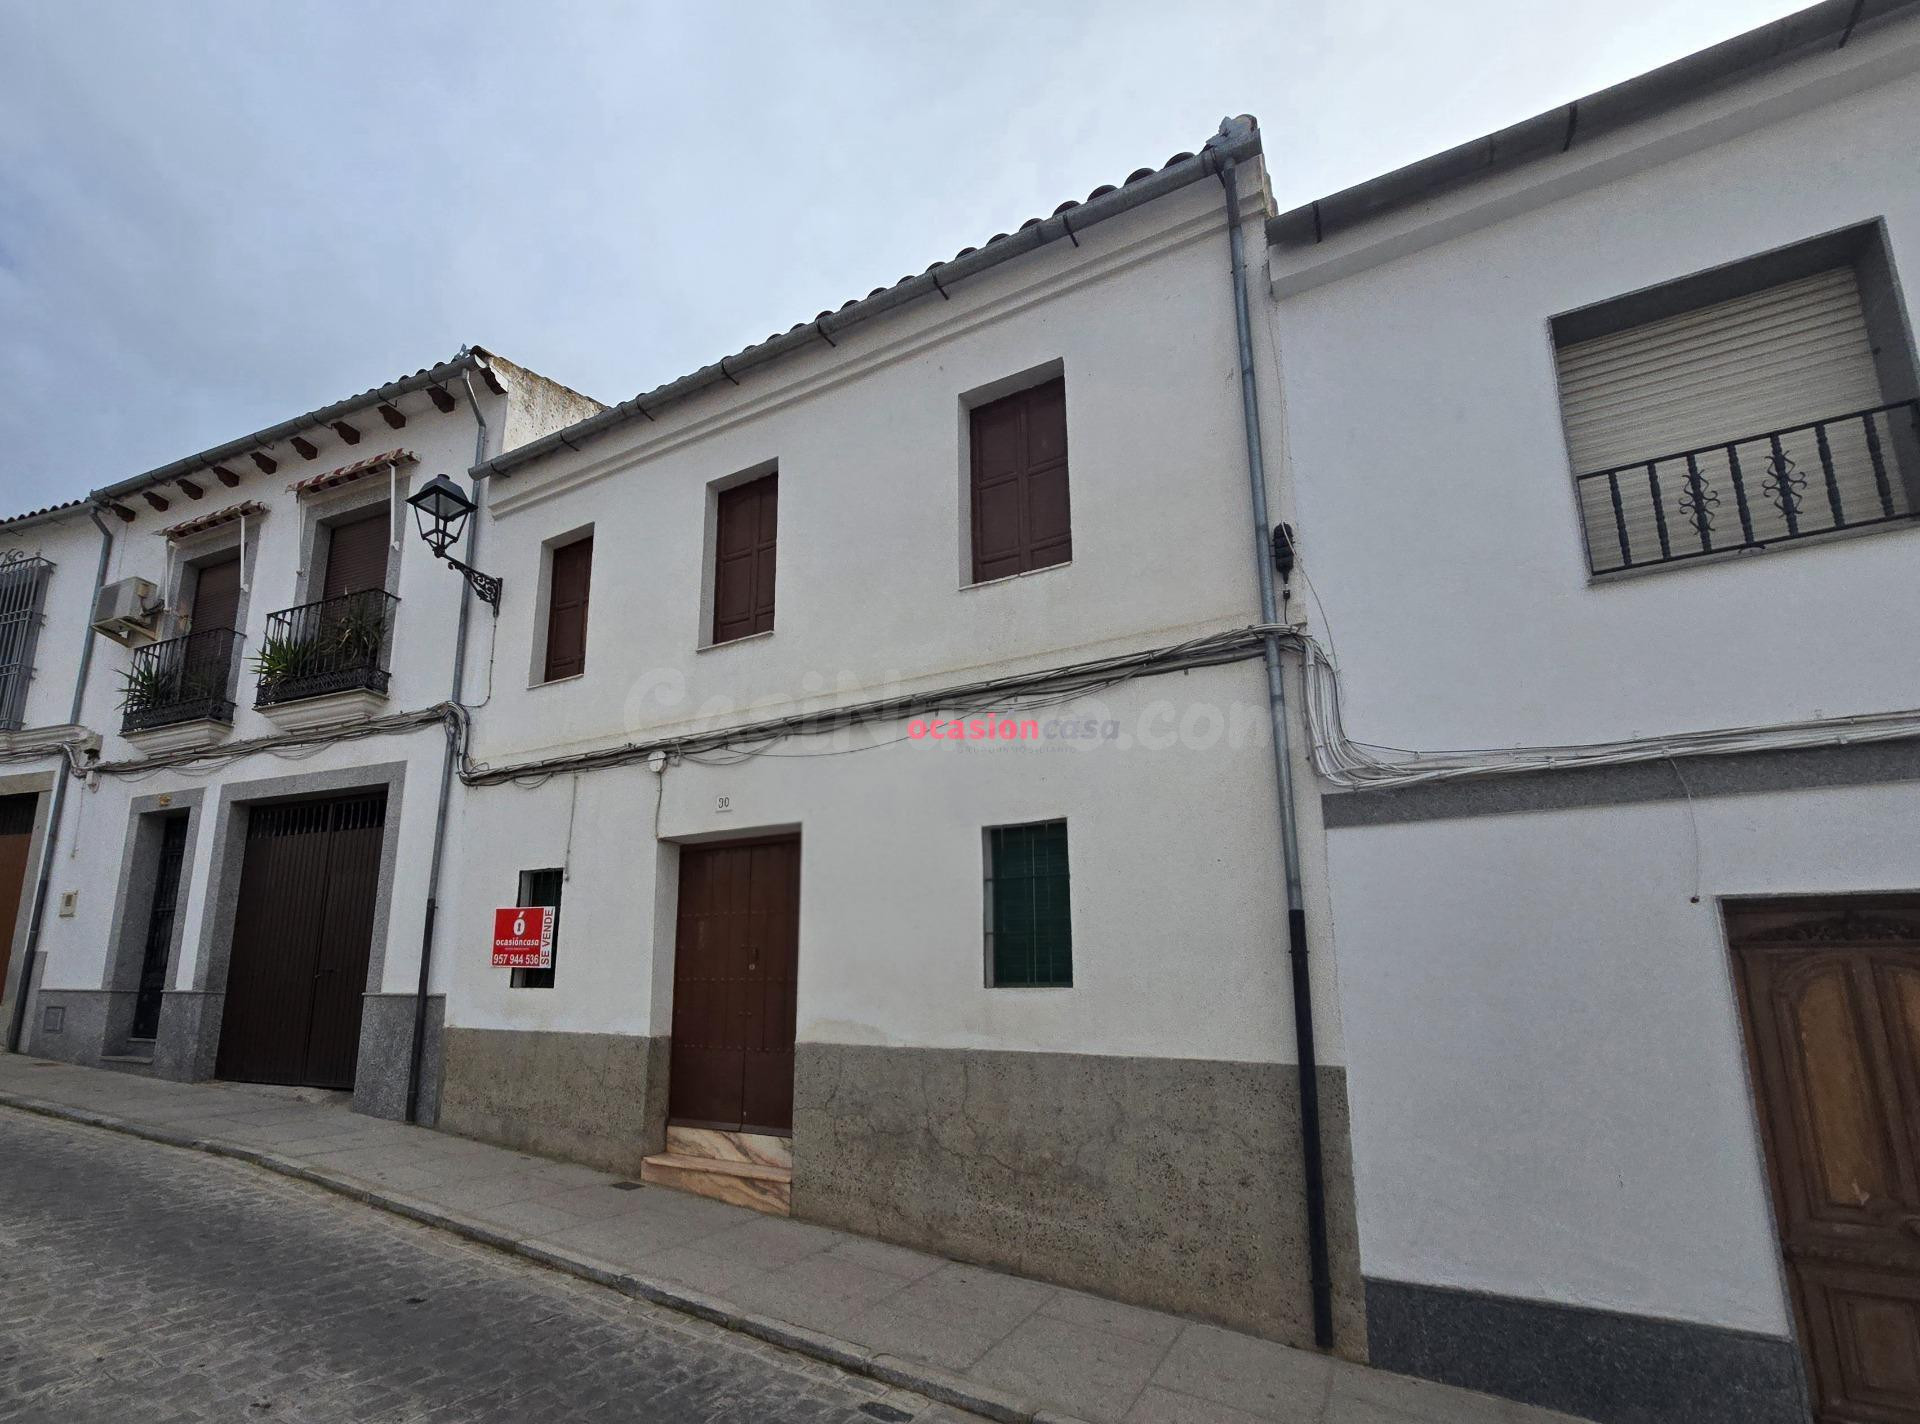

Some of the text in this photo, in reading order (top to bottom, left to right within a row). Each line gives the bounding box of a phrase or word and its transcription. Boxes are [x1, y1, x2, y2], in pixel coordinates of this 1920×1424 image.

[541, 908, 553, 965] SE VENDE
[493, 954, 540, 965] 957 944 536
